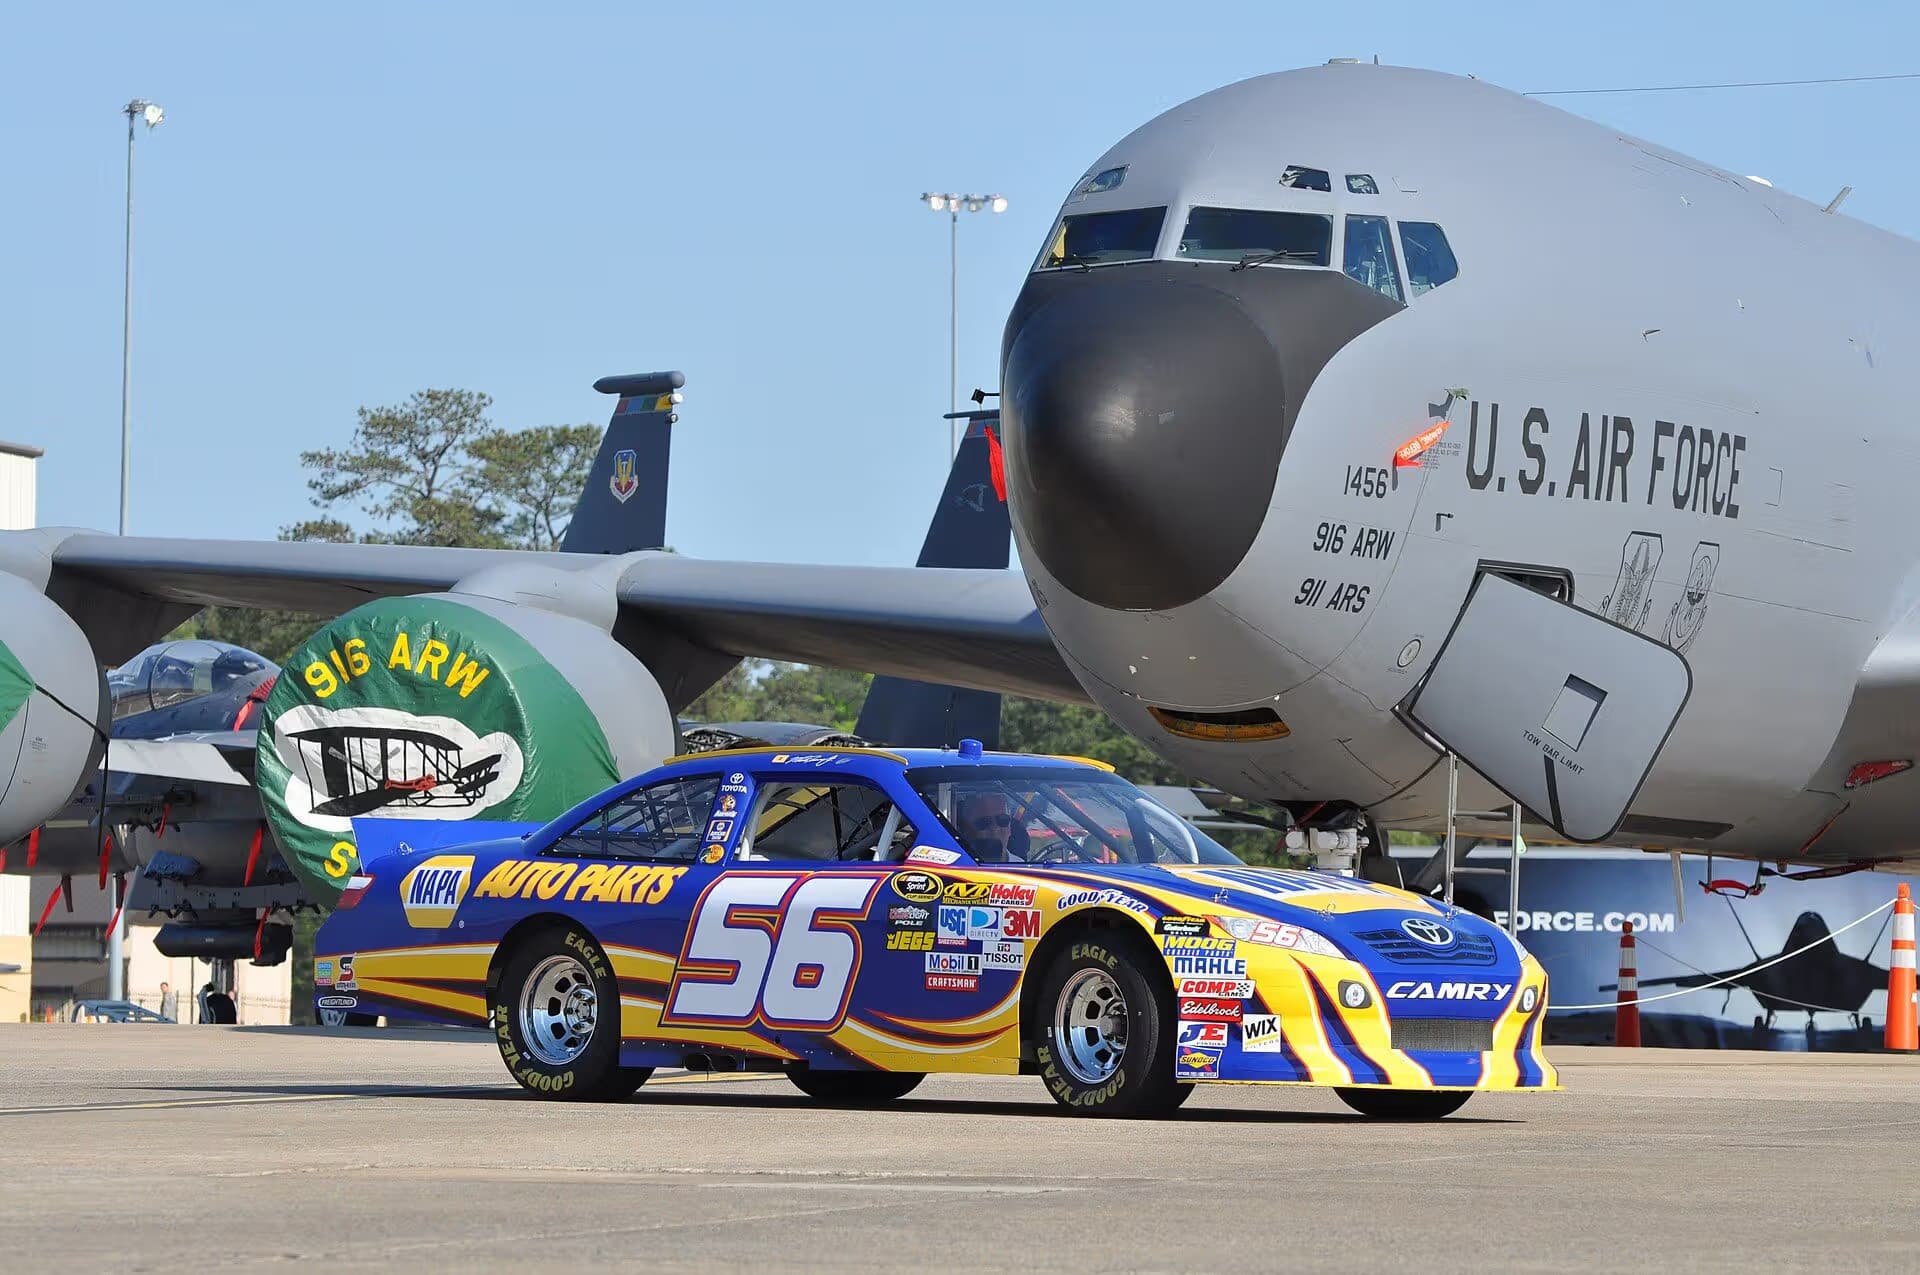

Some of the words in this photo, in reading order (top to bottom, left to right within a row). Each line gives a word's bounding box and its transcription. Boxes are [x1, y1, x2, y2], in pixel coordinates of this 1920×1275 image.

[1466, 400, 1555, 496] U.S.
[1566, 411, 1634, 503] AIR
[1647, 420, 1746, 519] FORCE
[1344, 464, 1389, 499] 1456
[1313, 522, 1348, 554] 916
[1351, 527, 1395, 561] ARW
[1295, 578, 1327, 606] 911
[1327, 582, 1371, 613] ARS
[304, 638, 371, 698] 916
[388, 632, 490, 698] ARW
[1523, 730, 1542, 746] TOW
[1542, 743, 1560, 760] BAR
[1560, 756, 1585, 775] LIMIT
[721, 784, 748, 794] TOYOTA
[408, 867, 459, 905] NAPA
[473, 860, 576, 900] AUTO
[564, 861, 690, 904] PARTS
[906, 881, 927, 892] Sprint
[990, 884, 1036, 906] Holley
[940, 908, 967, 937] USG
[1003, 910, 1040, 937] 3M
[887, 931, 936, 950] JEGS
[970, 930, 999, 938] DIRECTV
[1165, 935, 1235, 951] MOOG
[1250, 921, 1301, 948] 56
[564, 931, 606, 978] EAGLE
[664, 873, 889, 1030] 56
[929, 954, 964, 970] Mobil
[984, 952, 1023, 963] TISSOT
[1072, 943, 1119, 970] EAGLE
[1174, 957, 1246, 975] MAHLE
[928, 977, 975, 988] CRAFTSMAN
[1182, 980, 1237, 993] COMP
[1386, 981, 1512, 1000] CAMRY
[321, 998, 354, 1006] FREIGHTLINER
[1180, 1001, 1241, 1017] Edelbrock
[1178, 1023, 1226, 1044] JE
[1244, 1016, 1278, 1039] WIX
